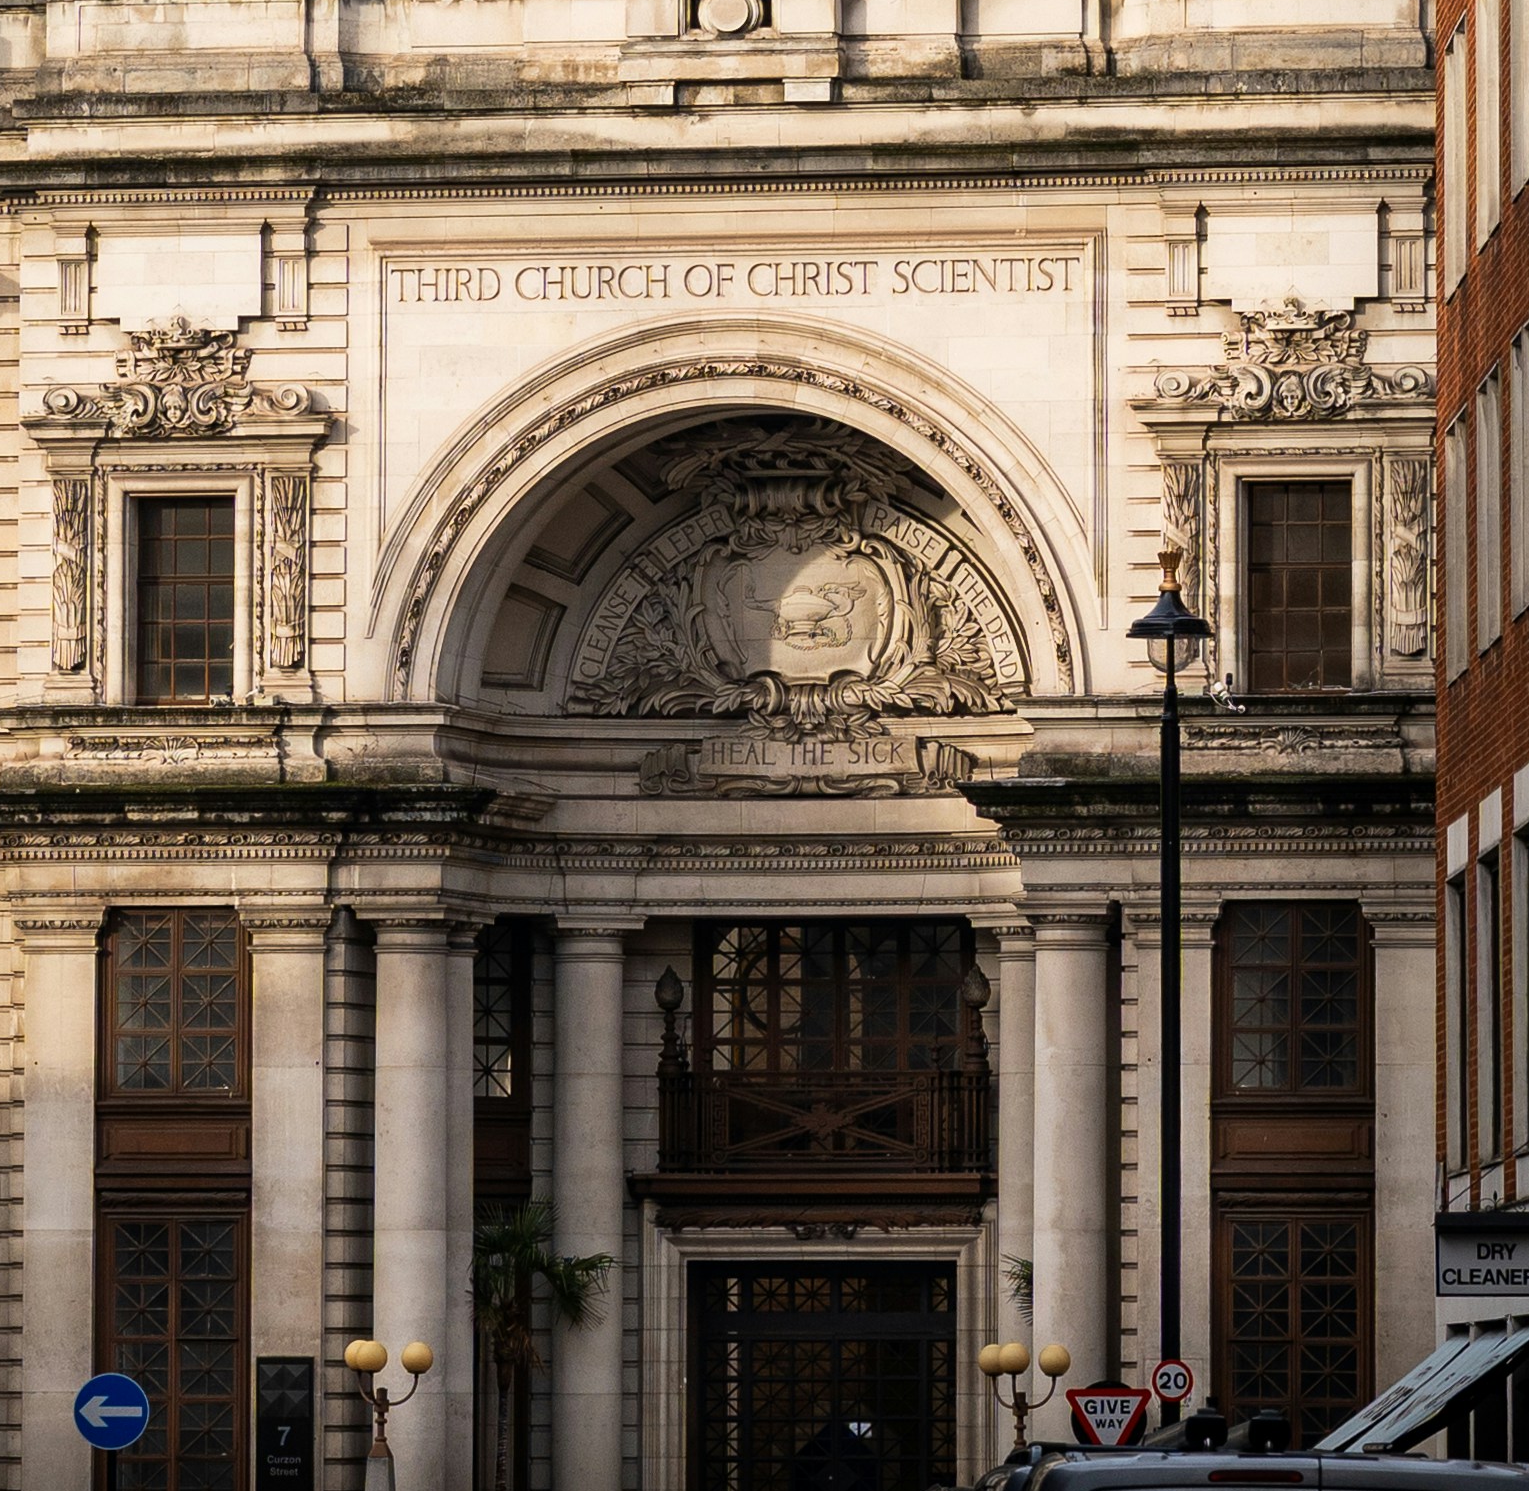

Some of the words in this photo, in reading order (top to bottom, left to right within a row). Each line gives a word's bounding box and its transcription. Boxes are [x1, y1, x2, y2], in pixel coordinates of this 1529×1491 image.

[391, 267, 501, 303] THIRD
[515, 264, 671, 300] CHURCH
[684, 263, 734, 298] OF
[748, 261, 878, 297] CHRIST
[892, 257, 1080, 294] SCIENTIST
[579, 585, 634, 678] CLEANSE
[653, 508, 730, 562] LEPER
[872, 507, 941, 560] RAISE
[958, 567, 994, 617] THE
[985, 616, 1018, 679] DEAD
[710, 741, 776, 766] HEAL
[786, 741, 835, 766] THE
[848, 740, 905, 764] SICK
[1477, 1243, 1517, 1260] DRY
[1159, 1372, 1187, 1389] 20
[1084, 1400, 1131, 1415] GIVE
[1095, 1419, 1124, 1429] WAY
[277, 1426, 292, 1447] 7
[266, 1455, 302, 1464] Curzon
[269, 1467, 300, 1476] Street
